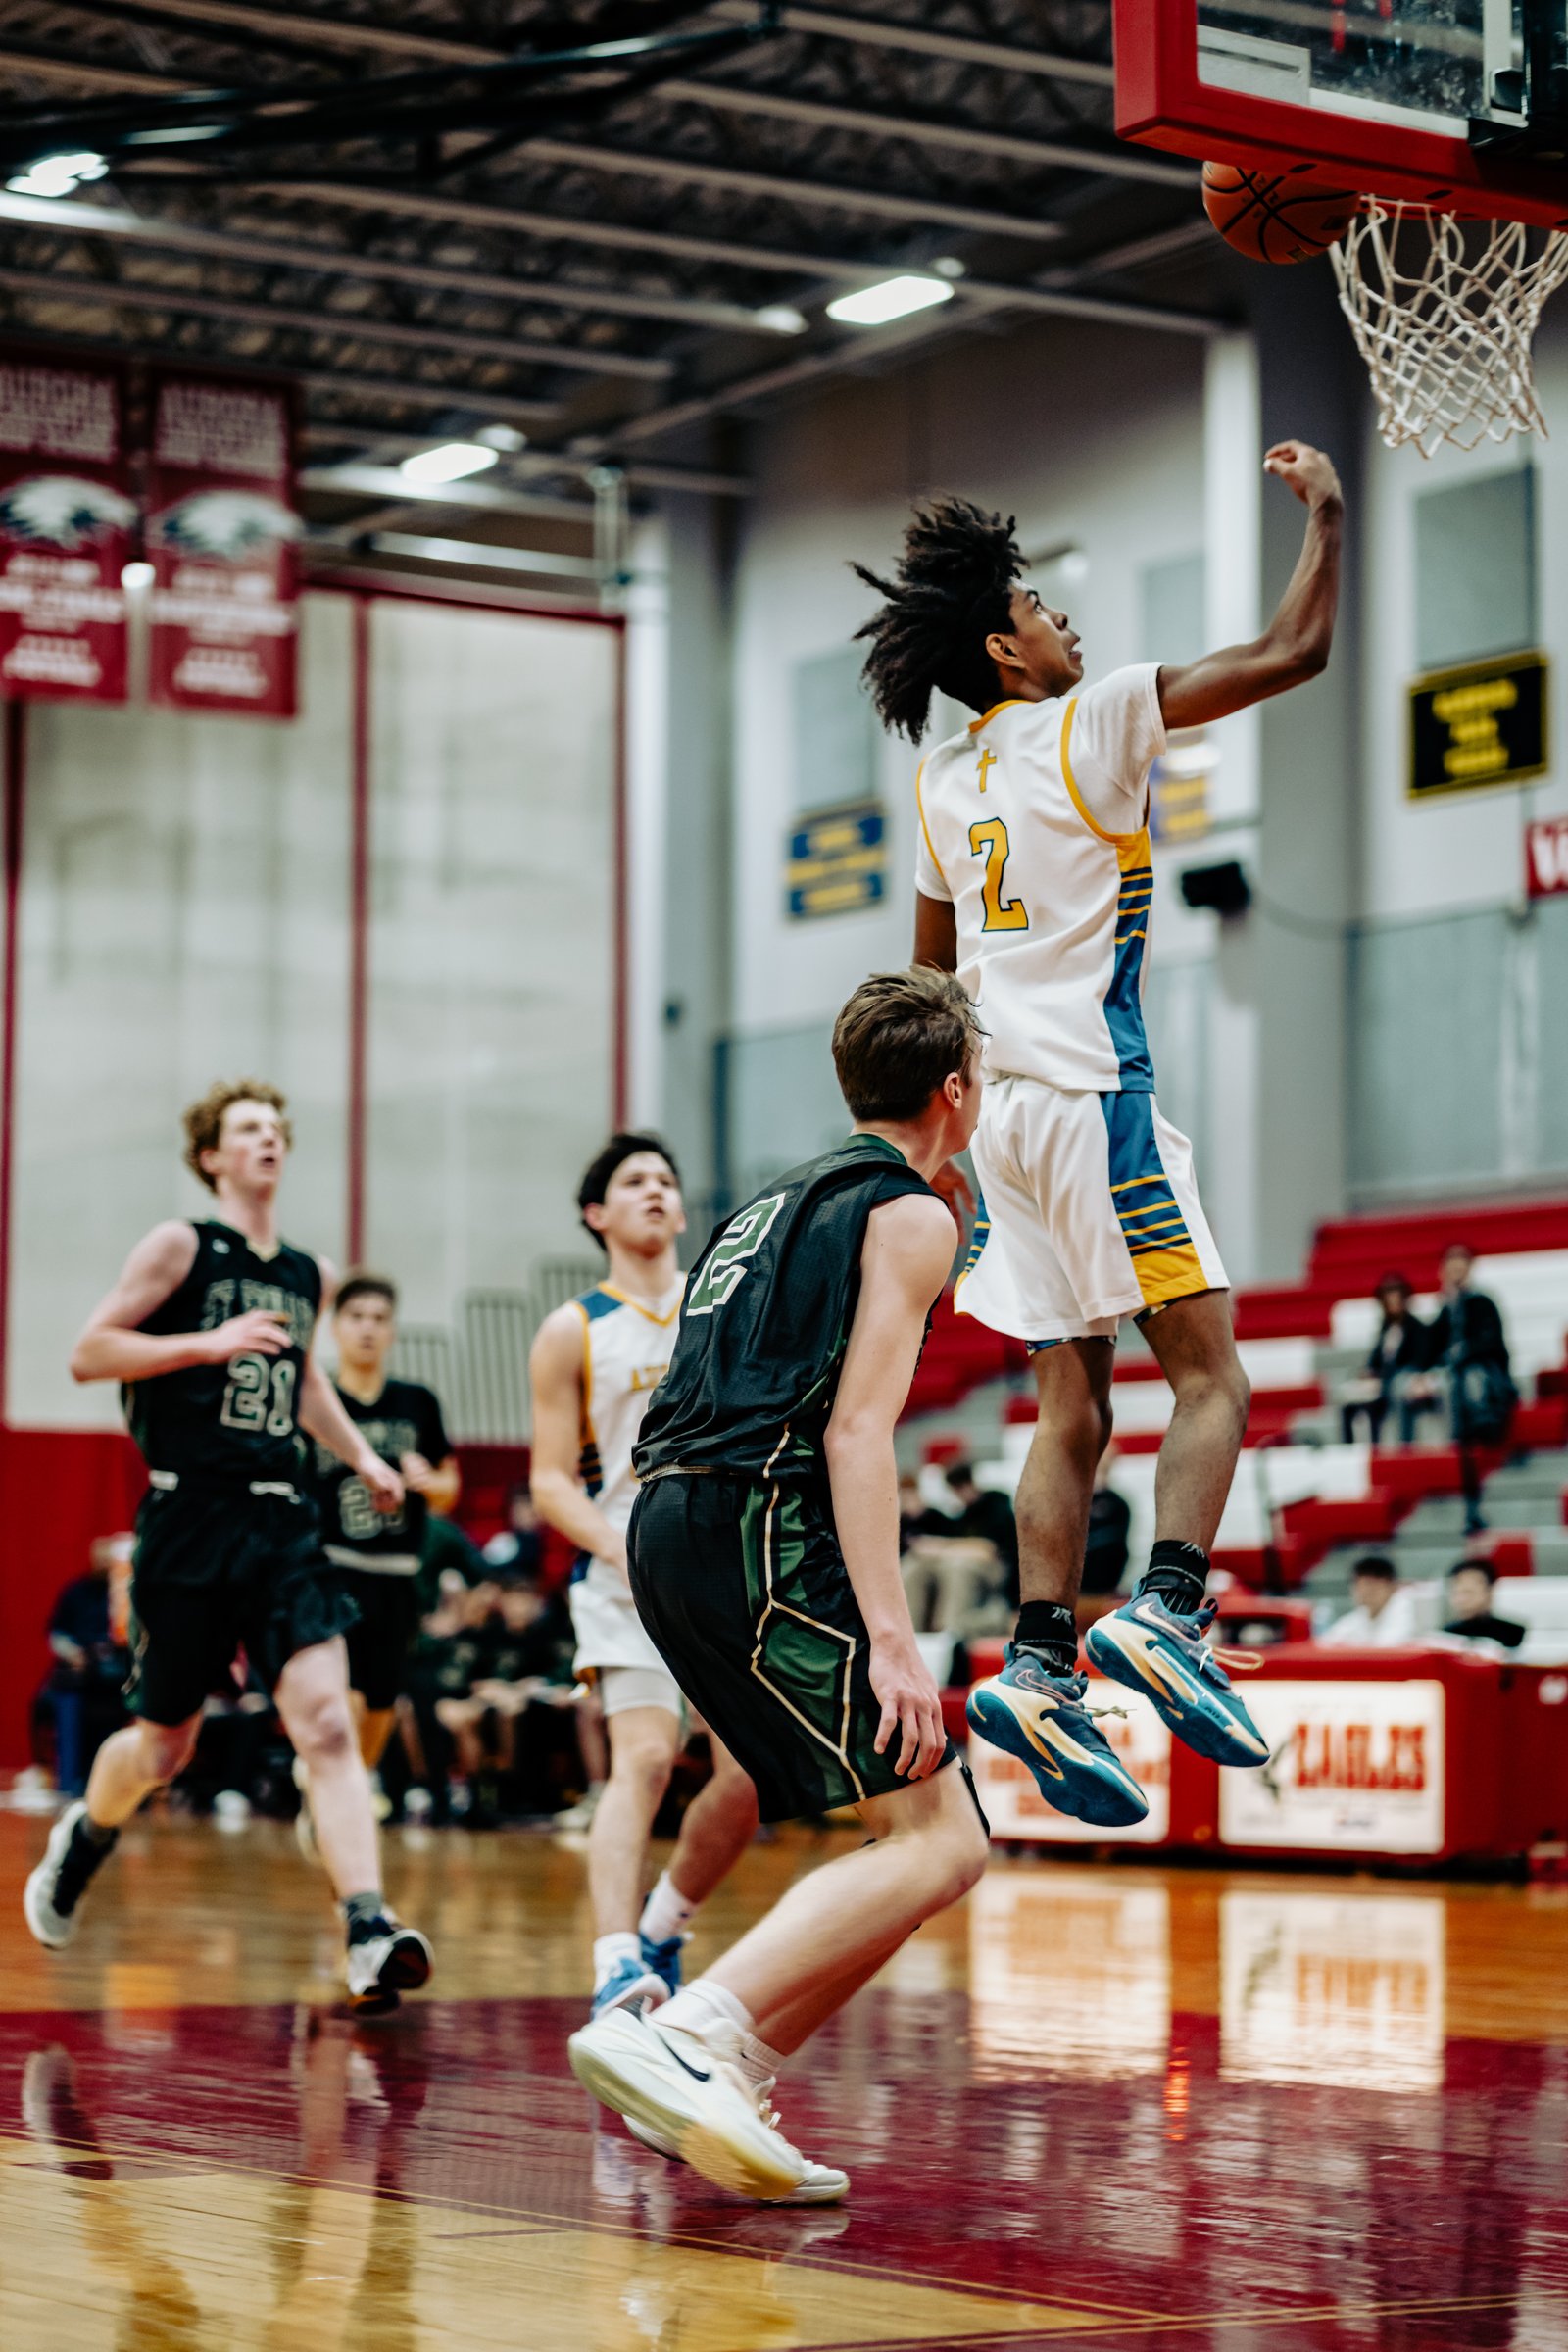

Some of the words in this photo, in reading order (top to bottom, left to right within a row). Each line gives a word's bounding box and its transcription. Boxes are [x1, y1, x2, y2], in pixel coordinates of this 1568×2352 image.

[968, 816, 1029, 933] 2
[686, 1192, 786, 1317] 2
[220, 1352, 297, 1437] 21
